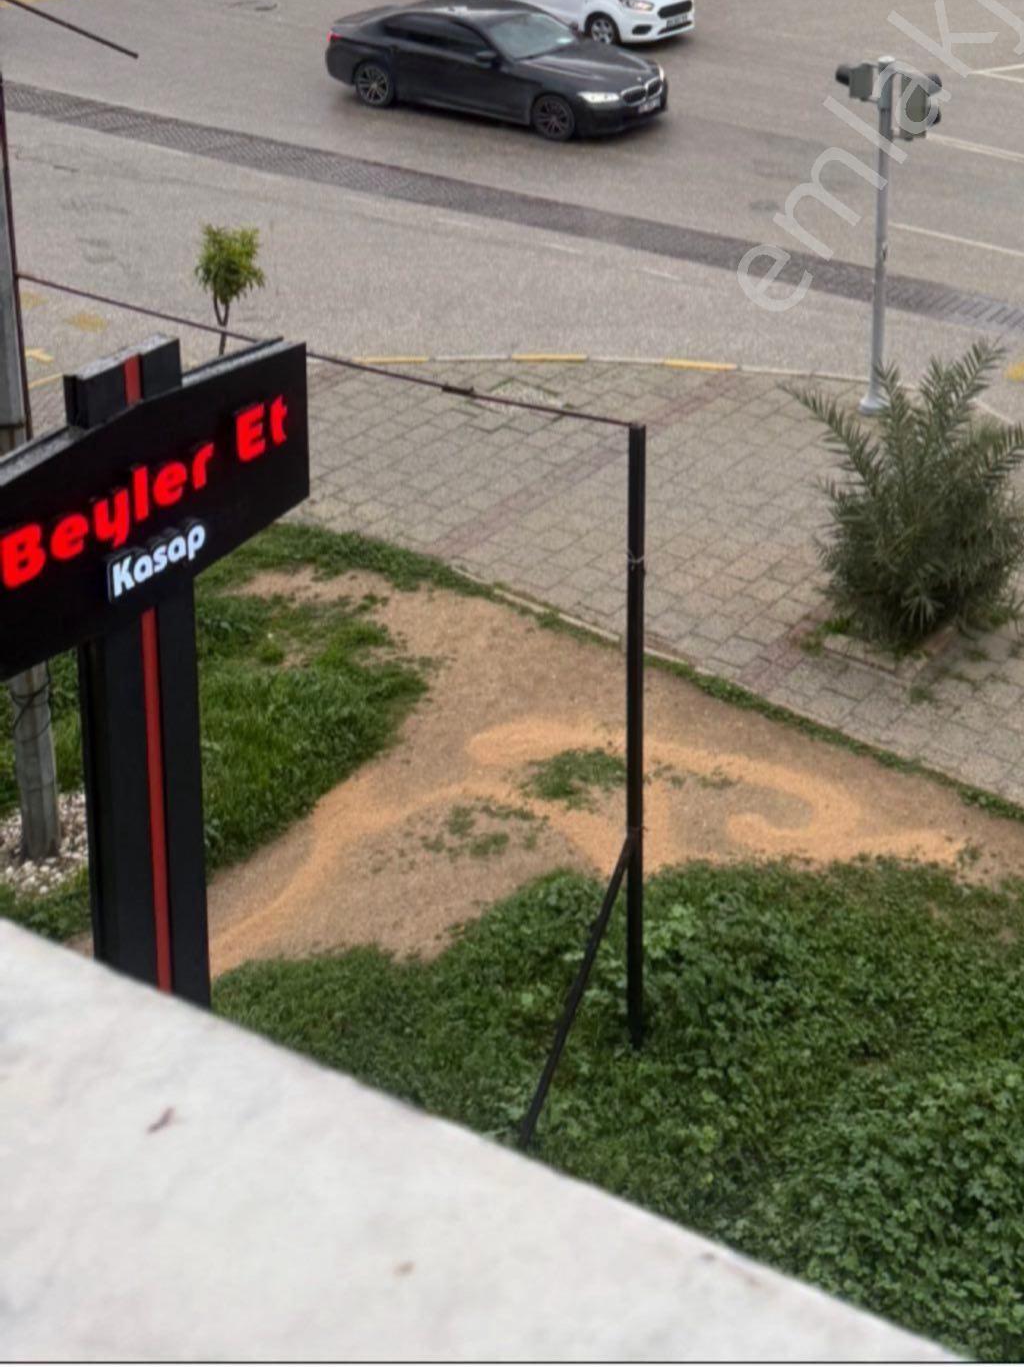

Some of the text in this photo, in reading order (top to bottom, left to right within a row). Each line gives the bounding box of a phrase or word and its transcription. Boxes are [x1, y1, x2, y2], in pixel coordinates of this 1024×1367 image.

[0, 395, 288, 588] Beyler Et
[111, 523, 206, 598] Kasap
